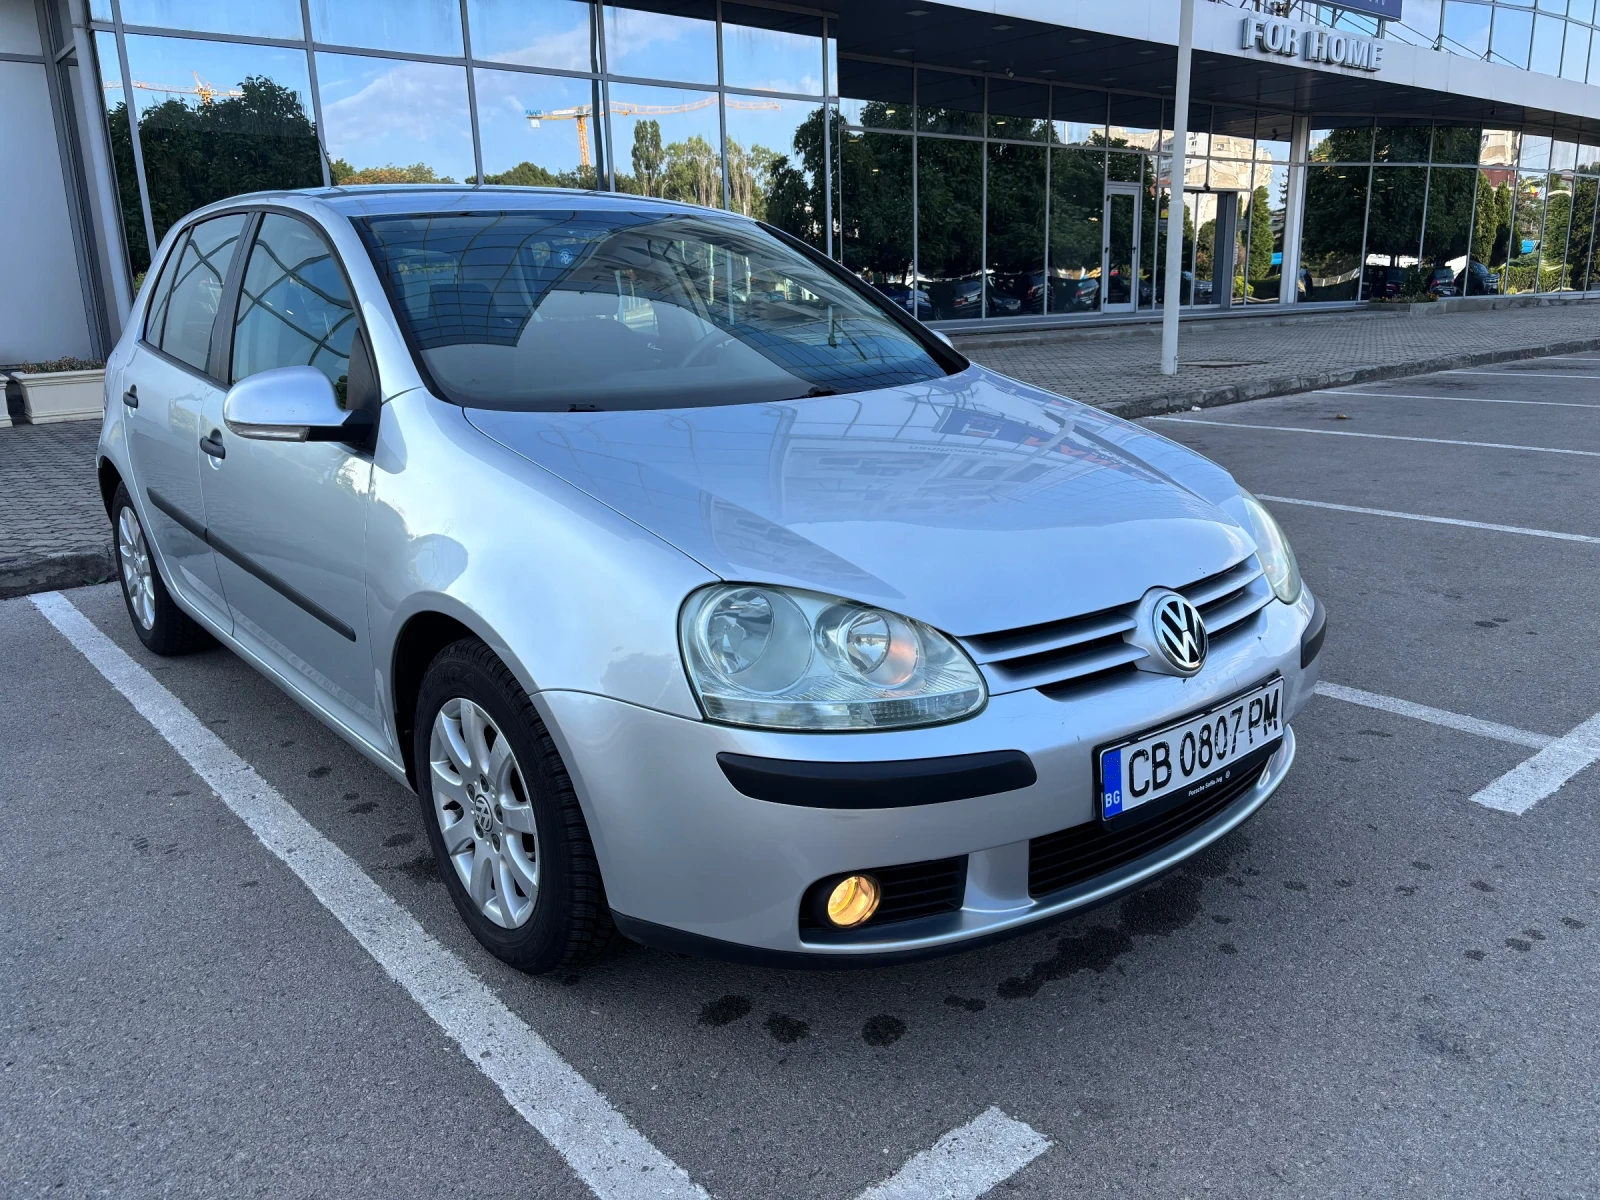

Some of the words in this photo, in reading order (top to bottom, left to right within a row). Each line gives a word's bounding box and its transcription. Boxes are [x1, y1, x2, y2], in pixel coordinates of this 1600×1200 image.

[1243, 17, 1300, 57] FOR
[1305, 30, 1383, 71] HOME
[1128, 741, 1172, 798] CB
[1179, 705, 1244, 777] 0807
[1248, 687, 1279, 744] PM
[1105, 791, 1120, 808] BG
